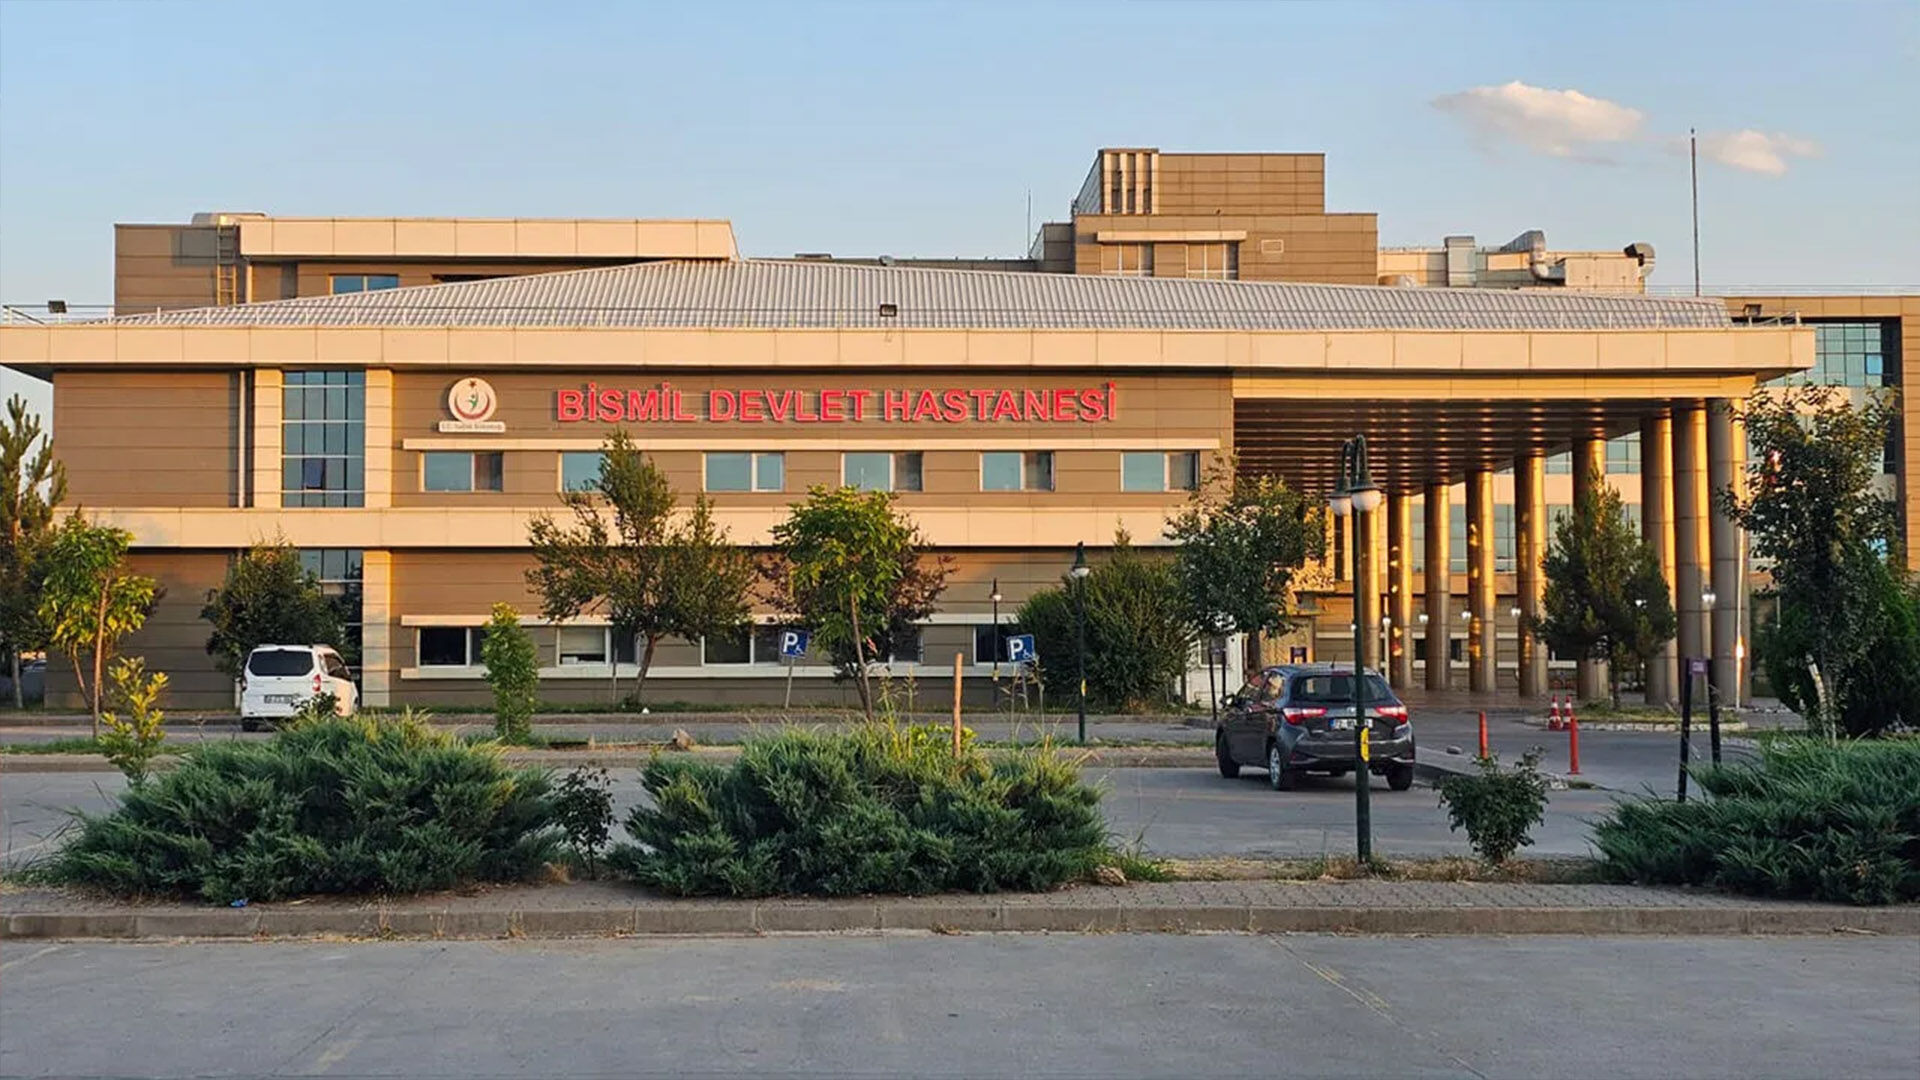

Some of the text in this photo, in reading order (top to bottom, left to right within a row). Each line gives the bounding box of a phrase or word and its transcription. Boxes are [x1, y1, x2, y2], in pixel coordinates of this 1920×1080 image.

[557, 381, 1117, 422] BİSMİL DEVLET HASTANESİ
[783, 632, 798, 653] P
[1010, 639, 1024, 660] P
